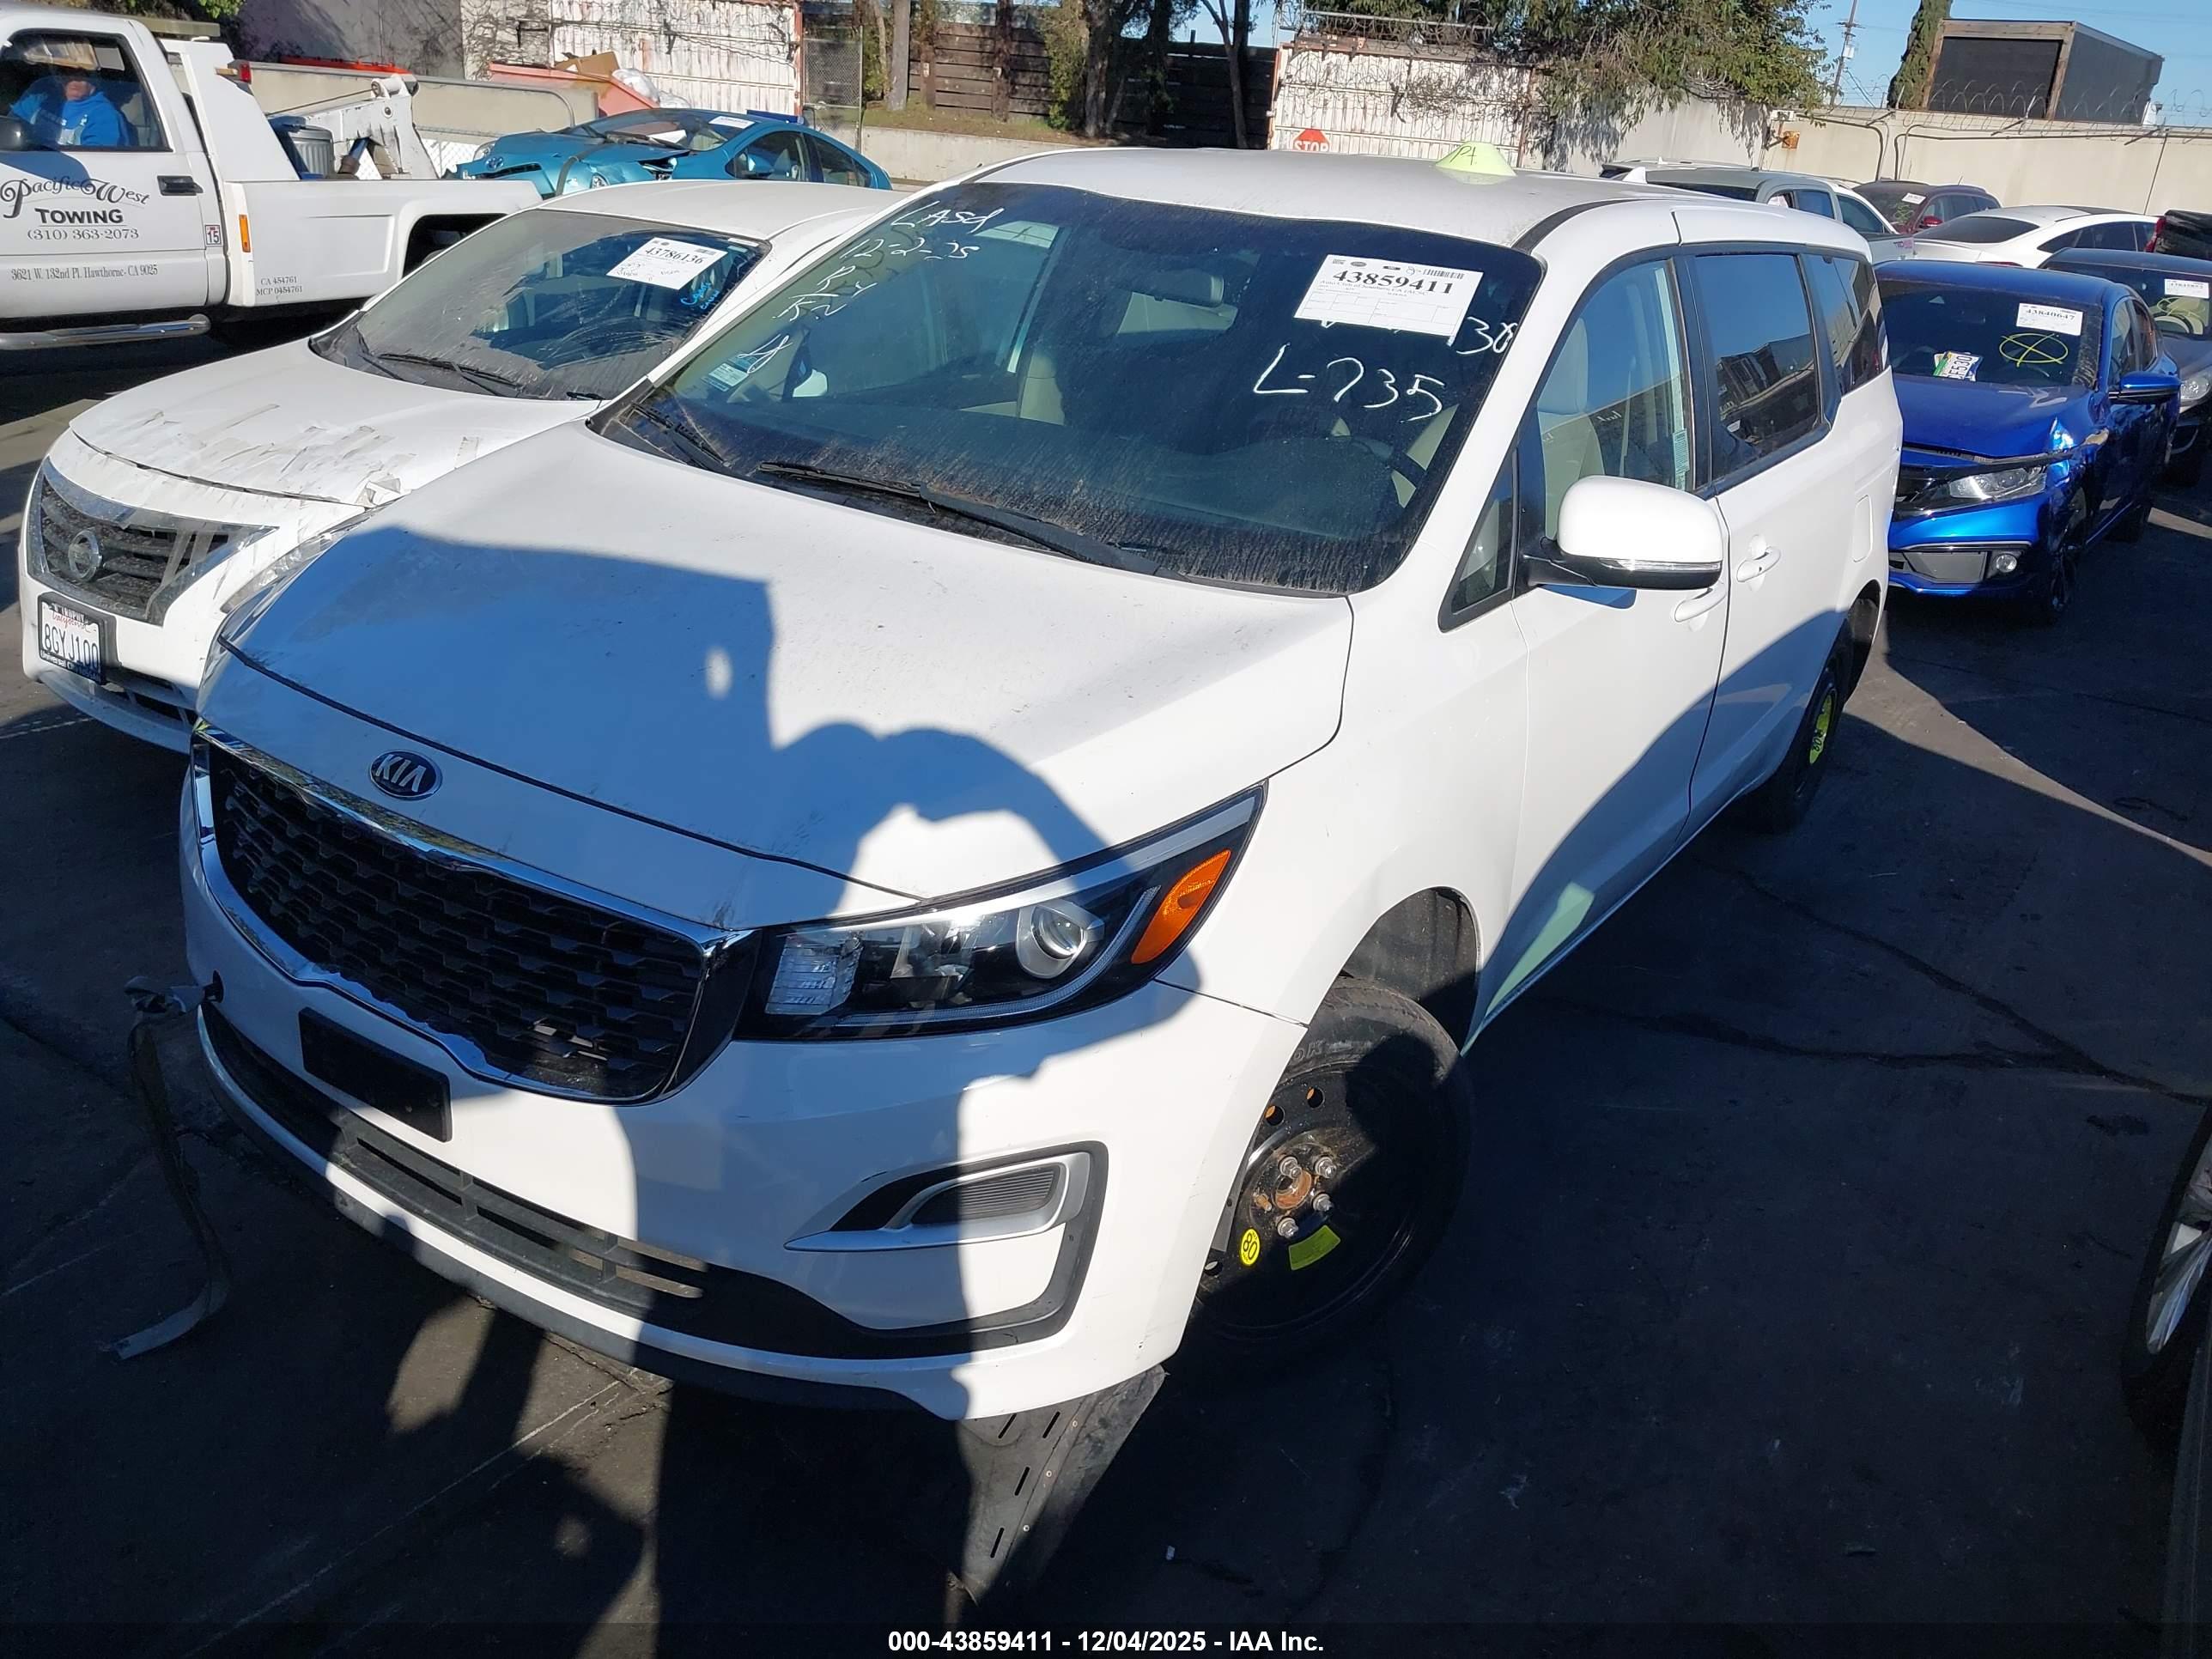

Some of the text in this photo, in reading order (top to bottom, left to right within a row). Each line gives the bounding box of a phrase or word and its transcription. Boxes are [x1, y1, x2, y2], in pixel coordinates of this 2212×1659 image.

[1295, 140, 1328, 151] STOP
[0, 175, 150, 219] Pacific West
[34, 208, 125, 224] TOWING
[27, 228, 68, 240] (310)
[207, 231, 220, 243] 15
[645, 246, 704, 264] 43786136
[11, 268, 32, 281] 3621
[46, 267, 70, 280] 132nd
[129, 264, 139, 276] CA
[273, 276, 298, 284] 454761
[257, 286, 302, 296] MCP 0454761
[1333, 270, 1454, 295] 43859411
[45, 623, 98, 670] 8GYJ100
[375, 754, 427, 793] KIA
[1243, 1232, 1258, 1260] 80
